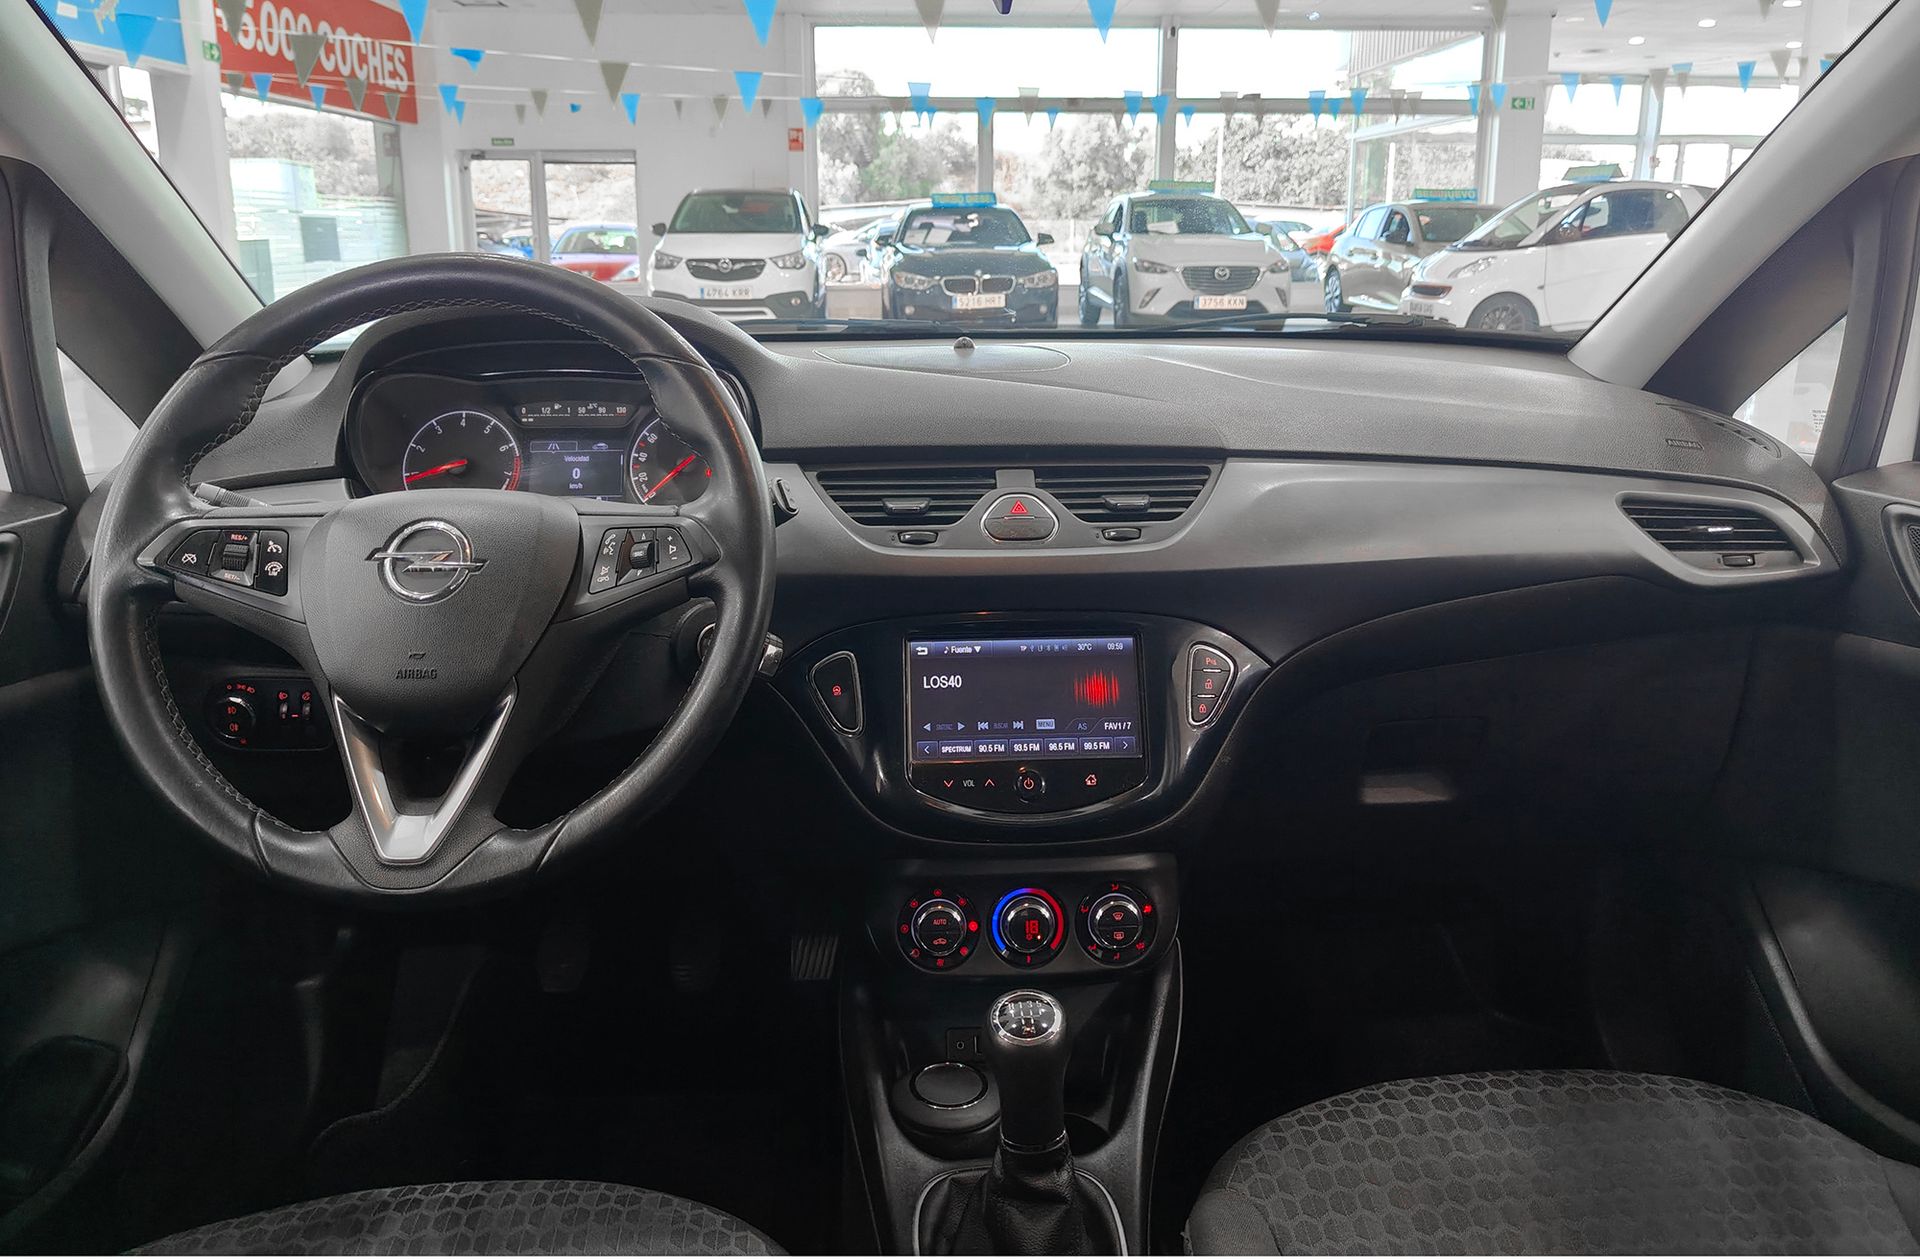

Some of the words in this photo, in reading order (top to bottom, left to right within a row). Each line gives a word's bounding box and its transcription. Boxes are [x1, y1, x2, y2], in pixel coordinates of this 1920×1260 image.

[317, 20, 408, 92] COCHES
[616, 406, 627, 414] 130
[435, 425, 443, 435] 3
[484, 424, 493, 434] 5
[646, 433, 658, 444] 60
[416, 444, 426, 453] 2
[499, 444, 509, 452] 6
[638, 452, 648, 463] 40
[572, 467, 580, 479] 0
[638, 472, 648, 483] 20
[951, 645, 973, 654] Fuente
[1077, 643, 1092, 651] 30°C
[395, 668, 438, 680] AIRBAG
[923, 675, 962, 689] LOS40
[1038, 721, 1054, 729] MENU
[1077, 723, 1088, 731] AS
[941, 745, 972, 754] SPECTRUM
[978, 744, 993, 753] 90.5
[994, 744, 1005, 753] FM
[1013, 743, 1028, 752] 93.5
[1028, 743, 1040, 752] FM
[1064, 742, 1075, 751] FM
[1099, 741, 1110, 750] FM
[962, 780, 975, 788] VOL
